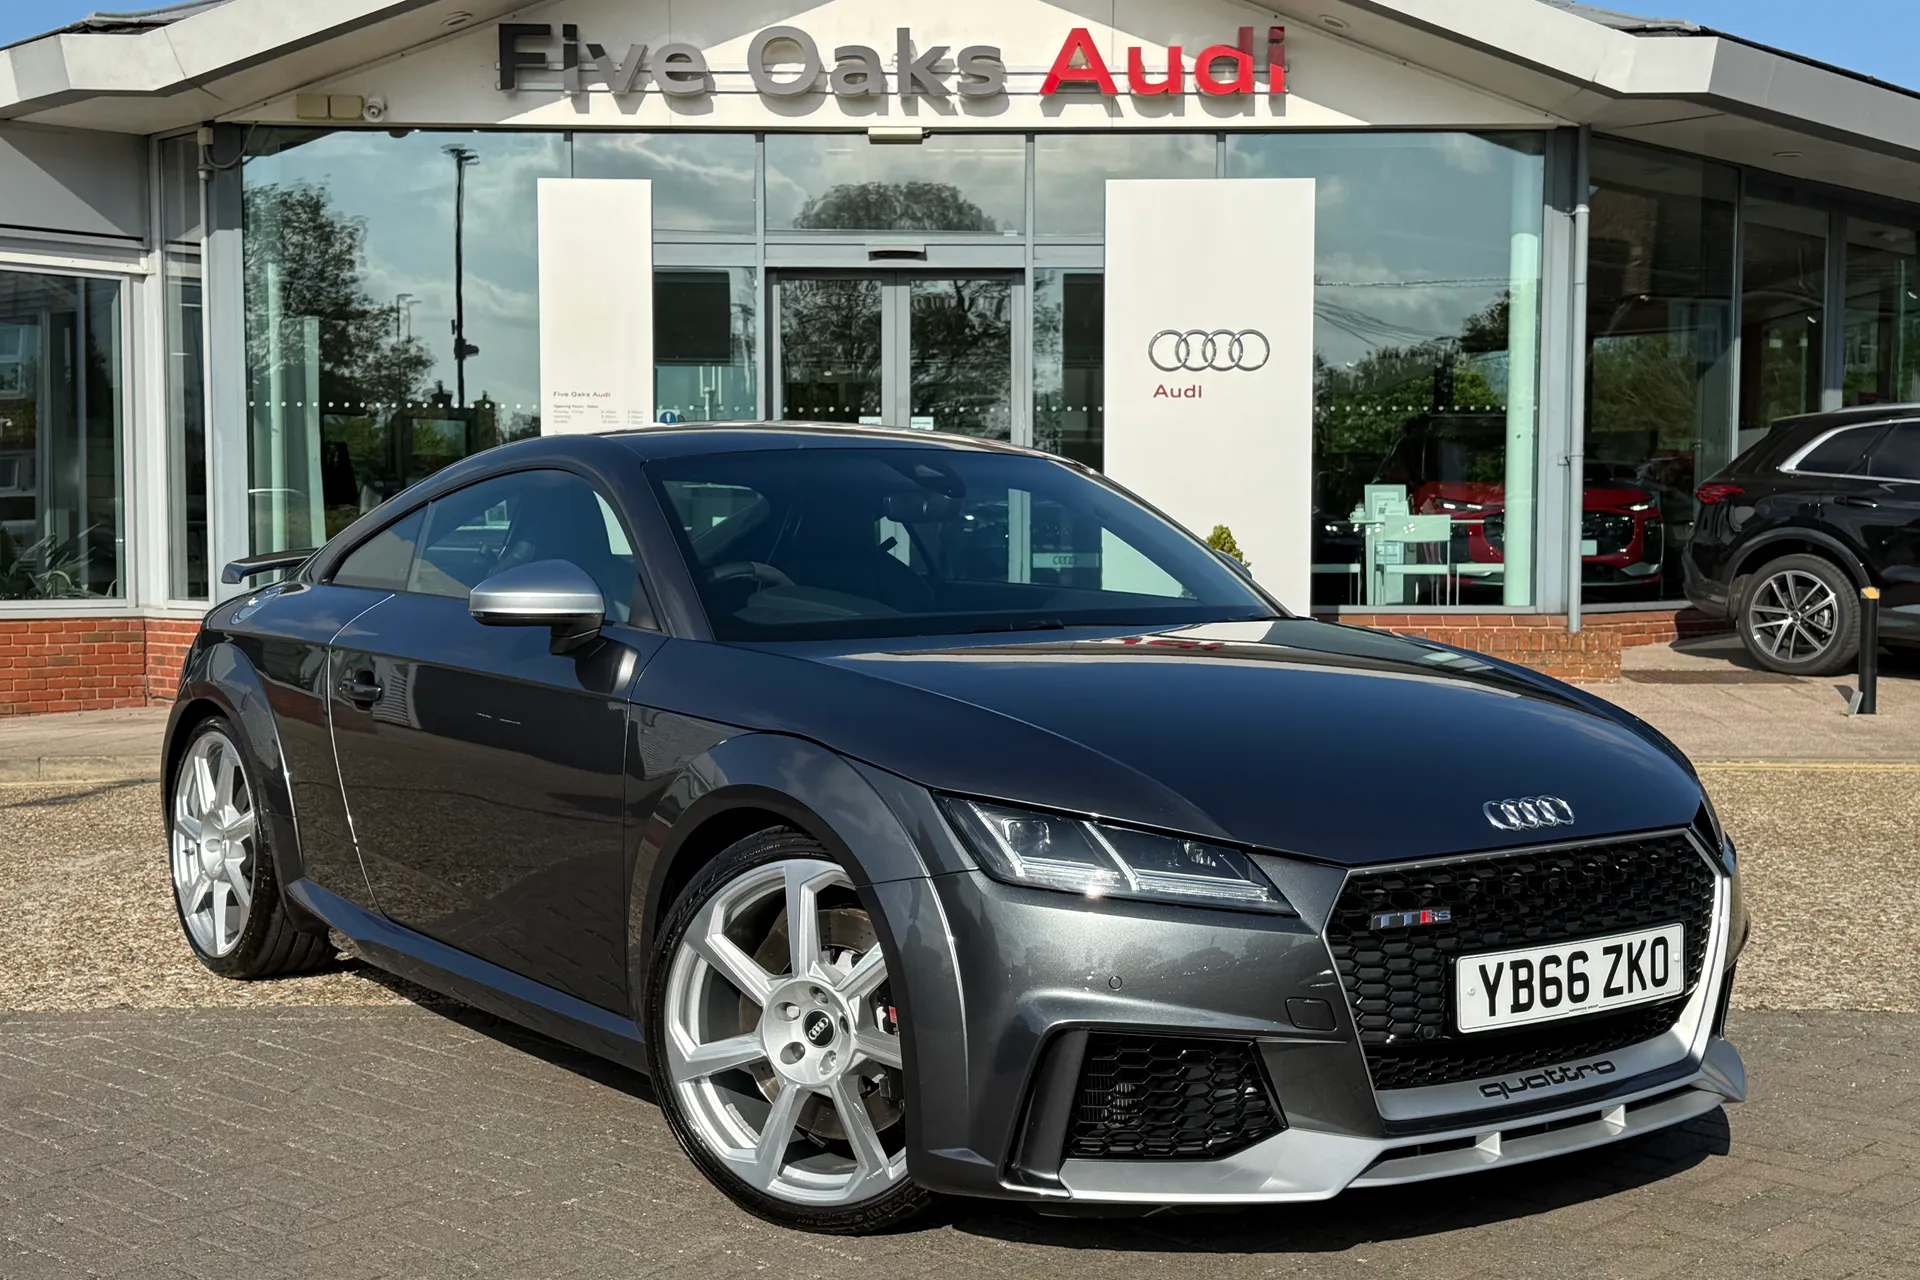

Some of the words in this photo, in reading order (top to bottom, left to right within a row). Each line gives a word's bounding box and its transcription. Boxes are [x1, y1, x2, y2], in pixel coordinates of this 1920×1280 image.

[499, 24, 707, 96] Five
[747, 26, 1002, 96] Oaks
[1039, 26, 1285, 95] Audi
[1152, 384, 1203, 399] Audi
[1478, 950, 1590, 1017] YB66
[1602, 936, 1670, 998] ZKO
[1478, 1059, 1617, 1100] quattro
